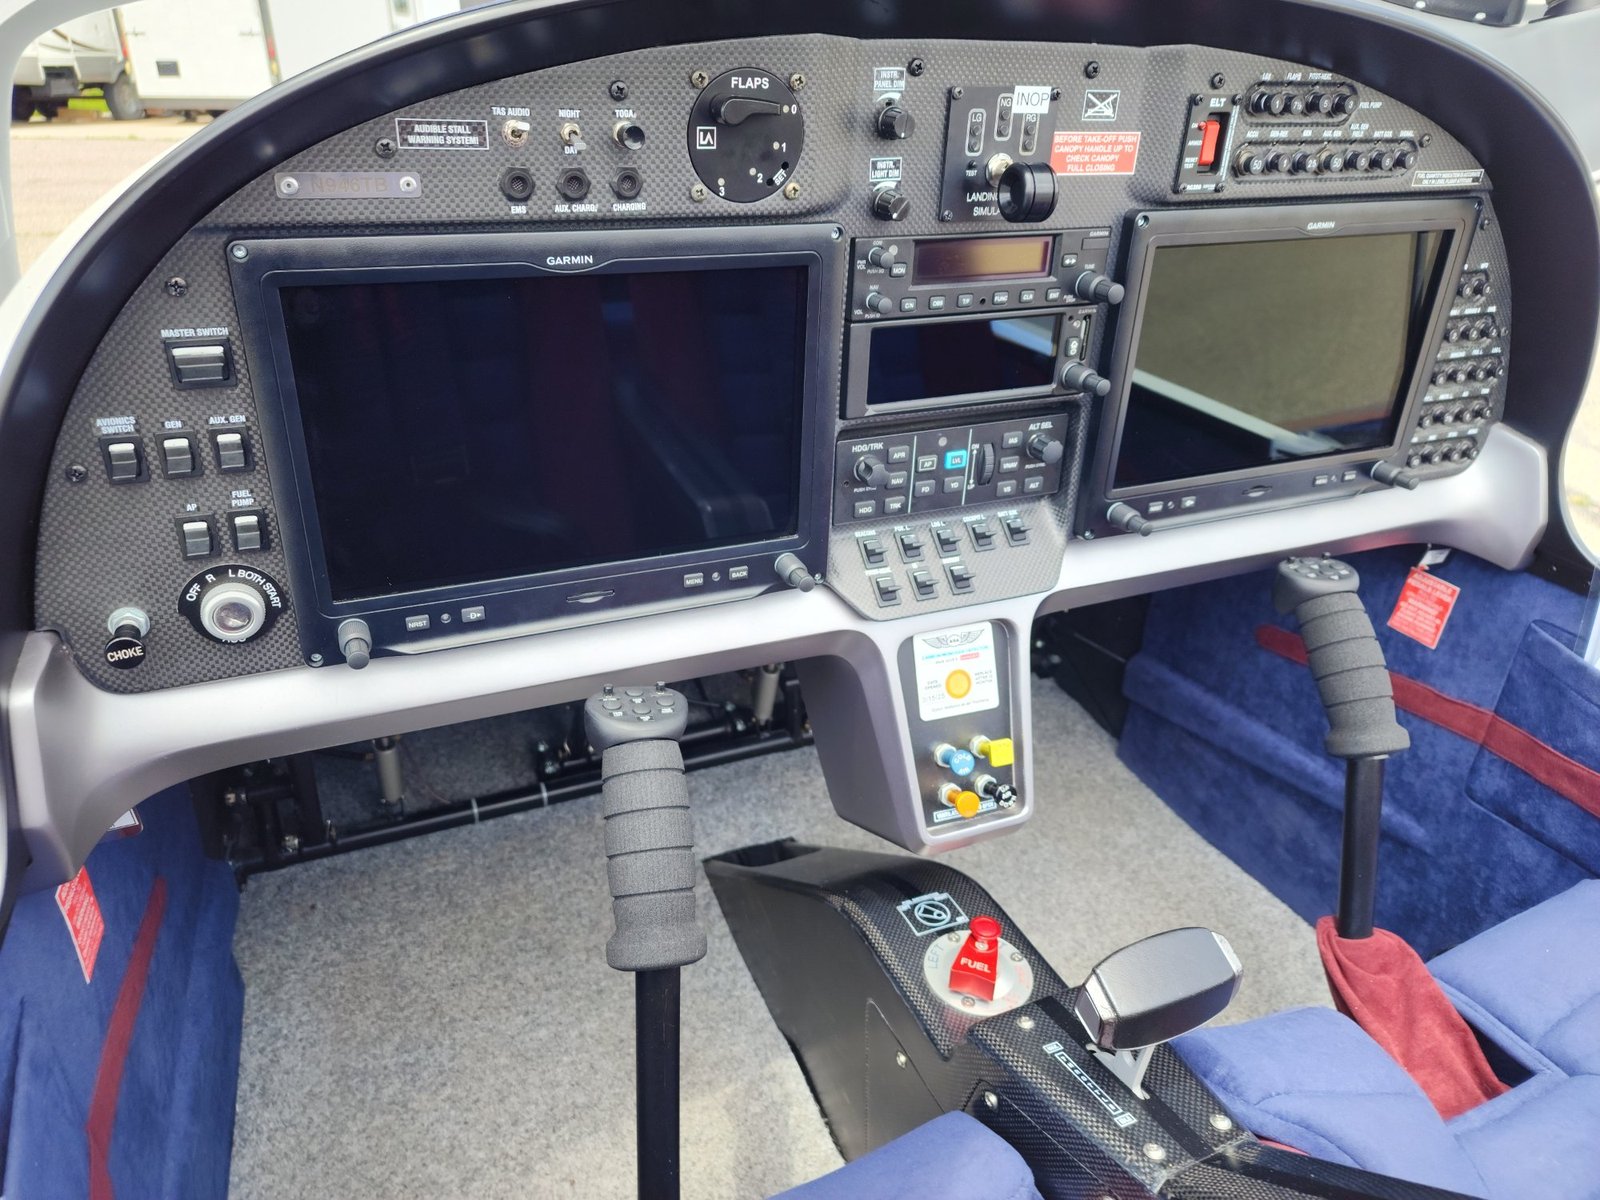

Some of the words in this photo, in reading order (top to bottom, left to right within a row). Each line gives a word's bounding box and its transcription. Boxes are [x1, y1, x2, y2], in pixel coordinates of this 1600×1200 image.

[730, 76, 770, 90] FLAPS
[874, 80, 893, 88] PANEL
[1000, 98, 1012, 107] NG
[1016, 91, 1050, 107] INOP
[1210, 97, 1227, 107] ELT
[491, 107, 506, 116] TAS
[507, 107, 531, 117] AUDIO
[558, 108, 581, 119] NIGHT
[790, 104, 798, 114] 0
[971, 114, 983, 122] LG
[1025, 114, 1037, 122] RG
[413, 124, 447, 134] AUDIBLE
[447, 125, 471, 135] STALL
[407, 135, 445, 144] WARNING
[1055, 135, 1083, 143] BEFORE
[1083, 135, 1117, 143] TAKE-OFF
[1117, 135, 1137, 143] PUSH
[781, 142, 787, 152] 1
[1055, 145, 1084, 153] CANOPY
[1084, 145, 1113, 153] HANDLE
[1113, 145, 1123, 153] UP
[1124, 145, 1134, 153] TO
[1066, 154, 1090, 162] CHECK
[1091, 154, 1120, 162] CANOPY
[1067, 164, 1084, 172] FULL
[1085, 164, 1116, 172] CLOSING
[756, 173, 764, 183] 2
[773, 170, 788, 186] SET
[871, 170, 888, 178] LIGHT
[888, 169, 900, 177] DIM
[718, 186, 725, 196] 3
[966, 191, 999, 202] LANDIN
[510, 205, 527, 215] EMS
[554, 204, 571, 213] AUX.
[612, 202, 647, 212] CHARGING
[973, 206, 1000, 216] SIMULA
[1307, 221, 1335, 230] GARMIN
[546, 254, 594, 266] GARMIN
[161, 328, 195, 338] MASTER
[196, 327, 229, 337] SWITCH
[96, 416, 136, 427] AVIONICS
[164, 420, 182, 429] GEN
[208, 416, 229, 425] AUX.
[229, 415, 246, 424] GEN
[101, 425, 135, 435] SWITCH
[1028, 422, 1040, 431] ALT
[1040, 421, 1054, 430] SEL
[851, 441, 884, 453] HDG/TRK
[893, 452, 906, 460] APR
[1029, 481, 1040, 489] ALT
[232, 489, 251, 498] FUEL
[186, 503, 198, 511] AP
[231, 498, 255, 507] PUMP
[858, 506, 873, 514] HDG
[205, 573, 216, 583] R
[731, 570, 748, 578] BACK
[685, 577, 703, 585] MENU
[186, 583, 202, 602] OFF
[228, 569, 236, 578] L
[237, 569, 266, 586] BOTH
[262, 582, 282, 609] START
[408, 620, 427, 629] NRST
[107, 645, 144, 663] CHOKE
[953, 752, 972, 764] COLD
[960, 957, 992, 973] FUEL
